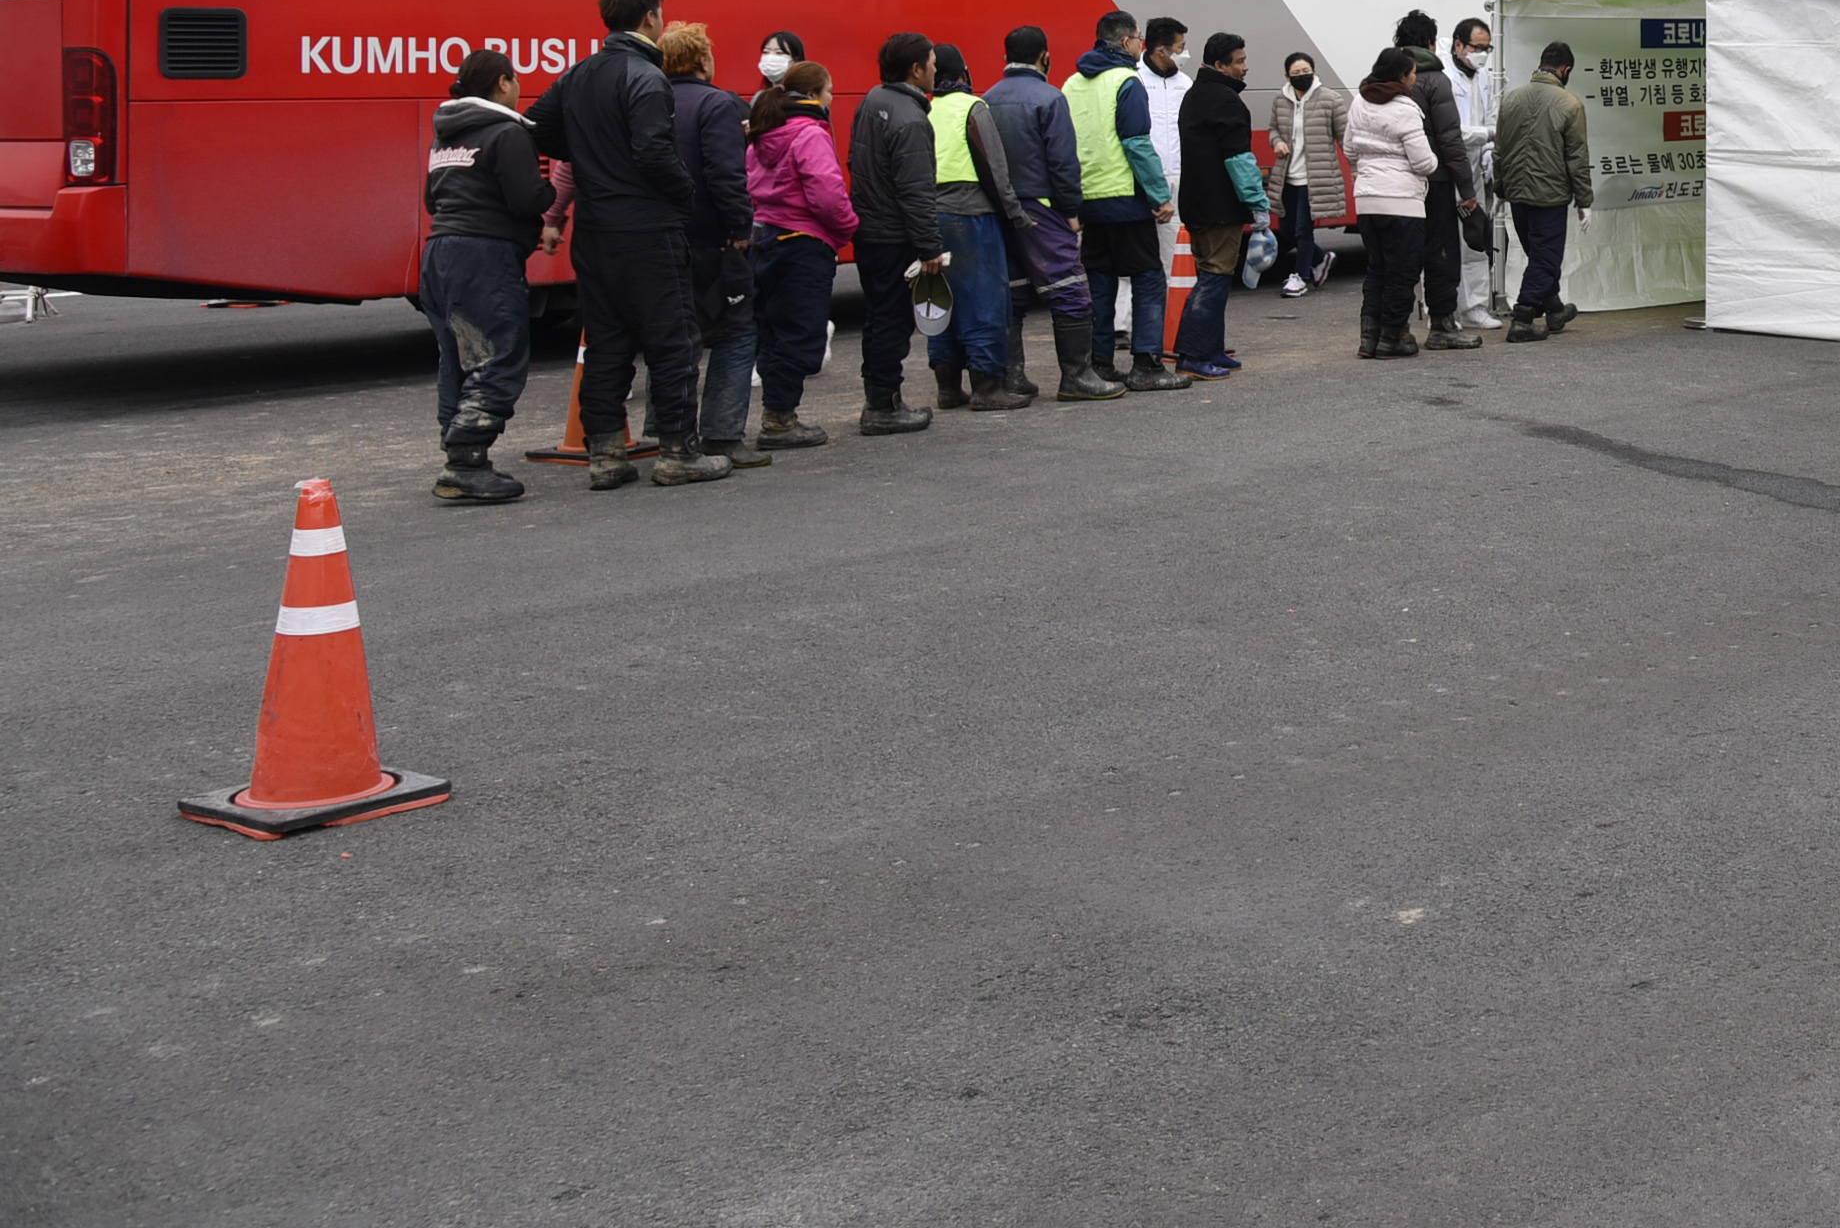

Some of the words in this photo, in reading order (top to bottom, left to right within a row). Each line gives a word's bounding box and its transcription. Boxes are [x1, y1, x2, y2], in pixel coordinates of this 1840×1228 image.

[301, 35, 471, 75] KUMHO
[1599, 58, 1657, 80] 환자발생
[1661, 58, 1706, 79] 유행지
[1640, 84, 1666, 105] 기침
[1671, 84, 1684, 105] 등
[1689, 83, 1706, 103] 호
[1600, 155, 1643, 175] 흐르는
[1647, 152, 1675, 174] 물에
[1665, 180, 1704, 199] 진도군
